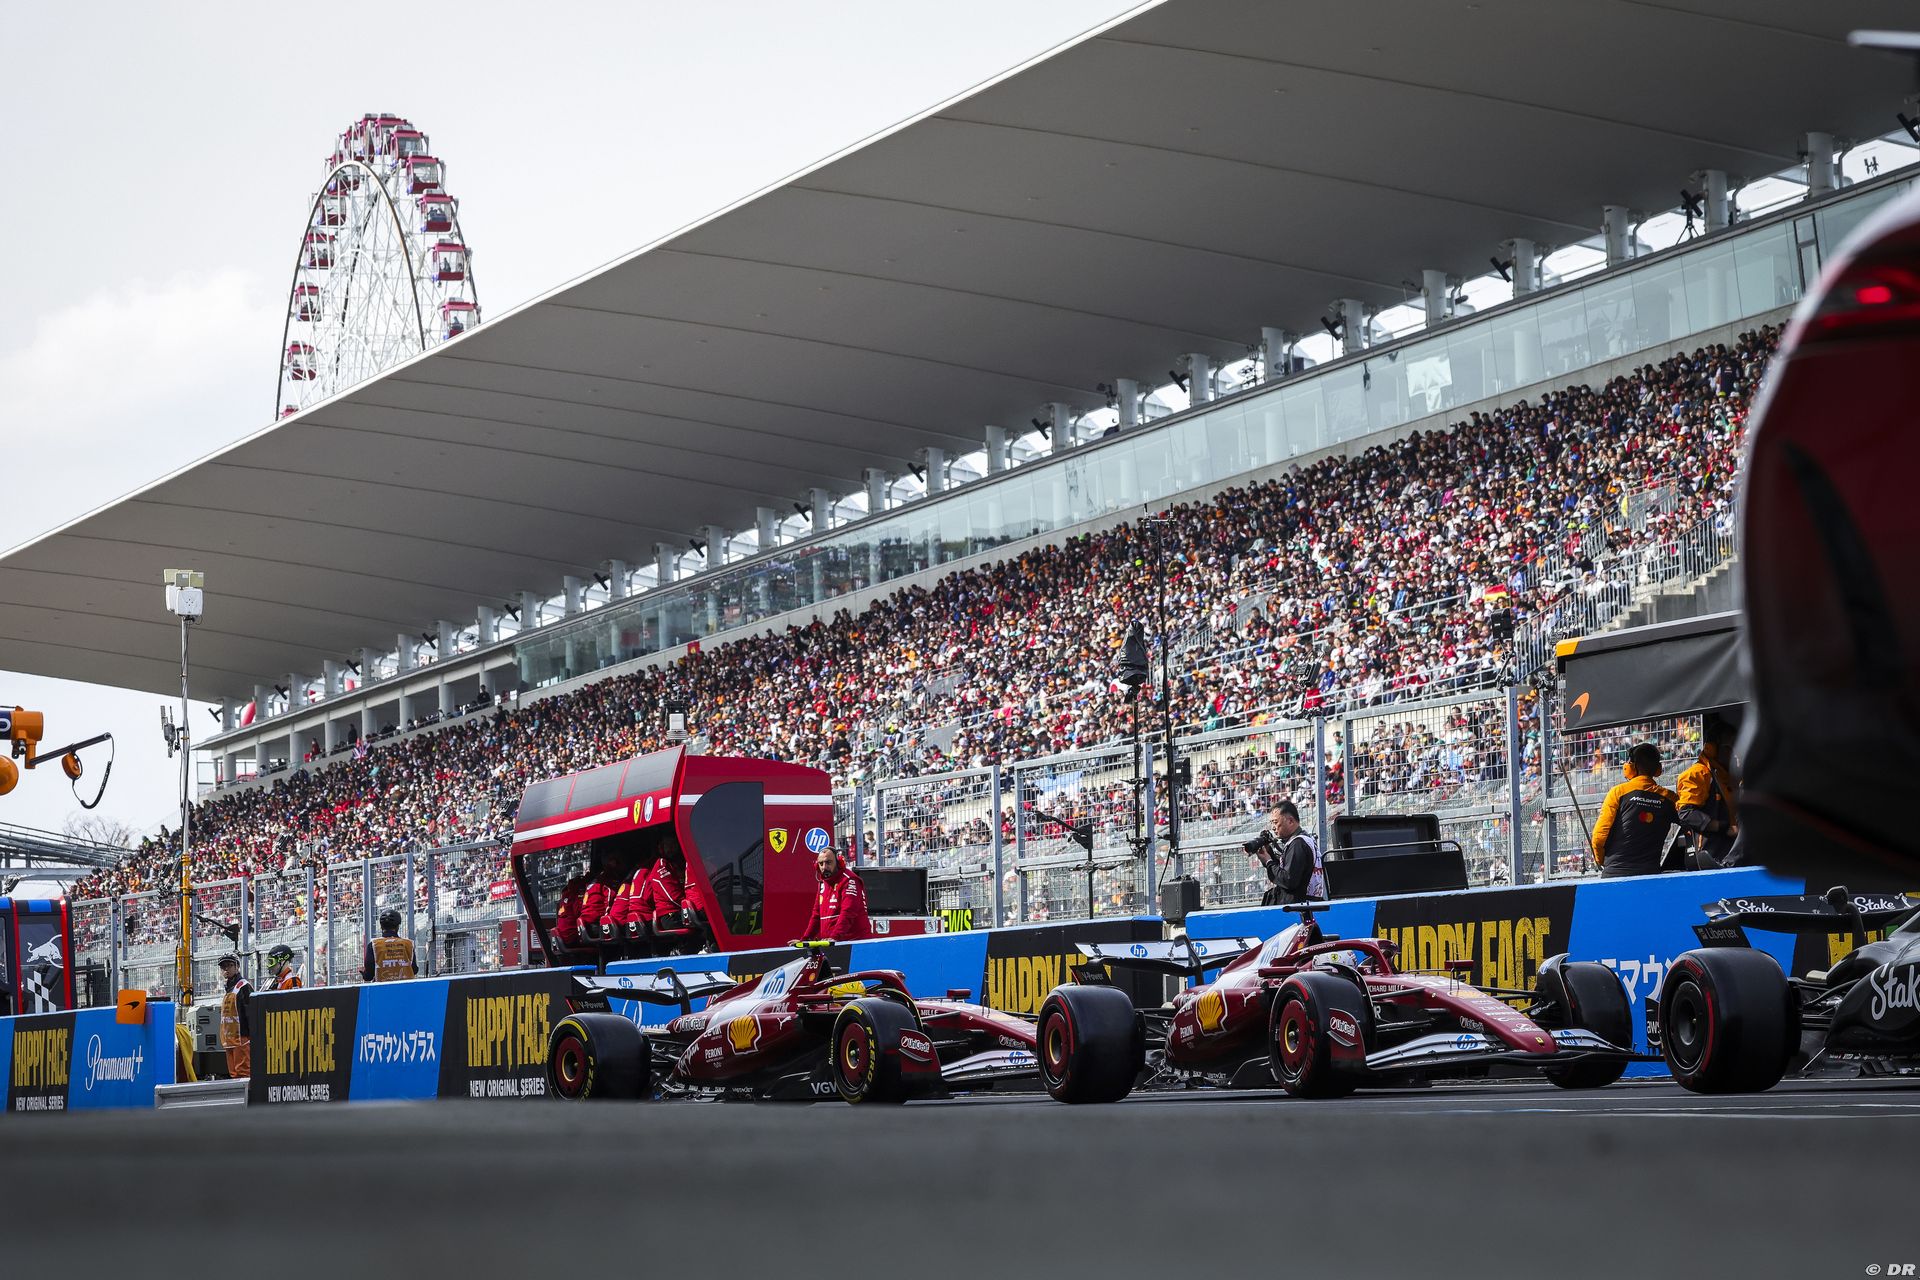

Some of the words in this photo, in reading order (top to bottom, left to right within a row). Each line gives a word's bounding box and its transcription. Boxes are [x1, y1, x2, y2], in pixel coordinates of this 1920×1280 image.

[1629, 796, 1662, 804] McLaren
[808, 829, 828, 850] hp
[1736, 899, 1775, 913] Stake
[1854, 896, 1896, 914] Stake
[1870, 961, 1920, 1021] Stak
[467, 995, 515, 1072] HAPPY
[516, 992, 551, 1070] FACE
[265, 1008, 306, 1080] HAPPY
[307, 1007, 336, 1076] FACE
[359, 1030, 436, 1064] パラマウントプラス
[704, 1046, 723, 1059] PERONI
[14, 1029, 45, 1090] HAPPY
[46, 1028, 69, 1087] FACE
[85, 1034, 144, 1091] Paramount+
[268, 1086, 282, 1103] NEW
[282, 1085, 310, 1101] ORIGINAL
[310, 1084, 330, 1100] SERIES
[469, 1080, 485, 1097] NEW
[487, 1079, 519, 1097] ORIGINAL
[520, 1077, 545, 1097] SERIES
[16, 1096, 26, 1111] NEW
[26, 1096, 48, 1111] ORIGINAL
[48, 1095, 64, 1110] SERIES
